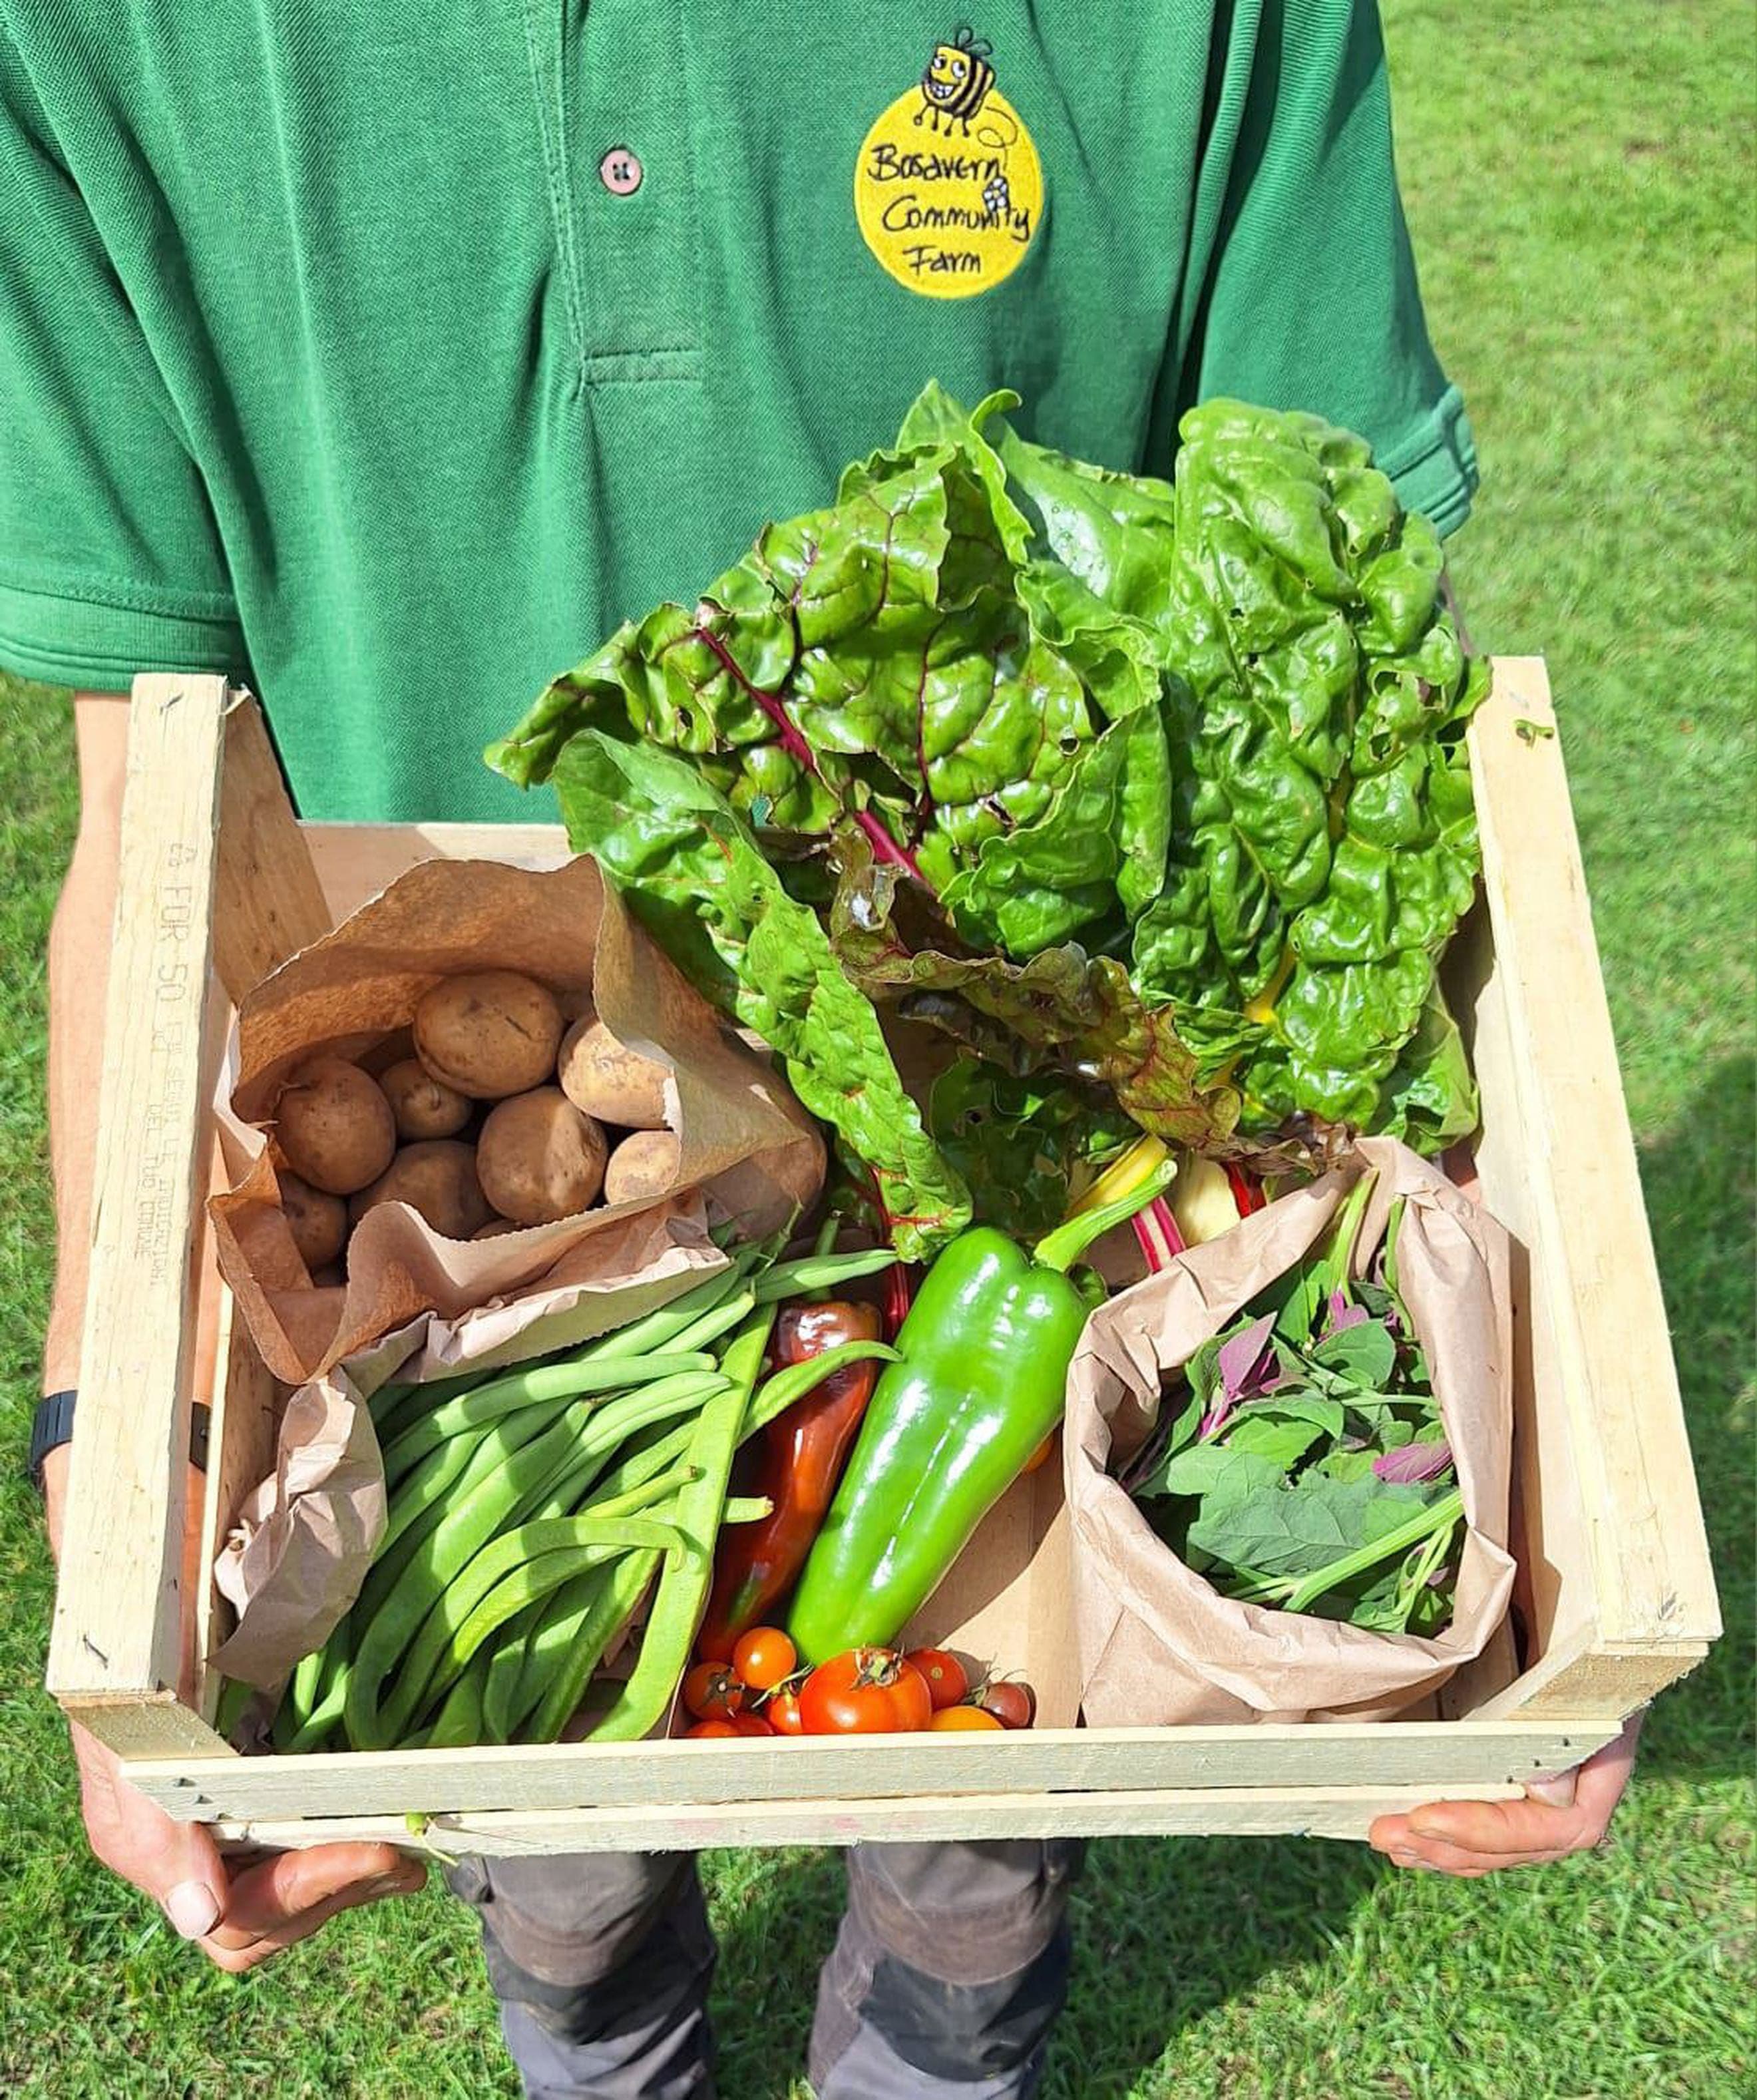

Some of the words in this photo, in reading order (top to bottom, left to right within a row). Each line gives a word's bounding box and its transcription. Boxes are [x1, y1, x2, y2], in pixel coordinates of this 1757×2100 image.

[867, 143, 1002, 181] Bosavern
[882, 194, 1030, 242] Community
[902, 245, 981, 274] Farm
[160, 886, 192, 941] FOR
[156, 964, 189, 1002] 50
